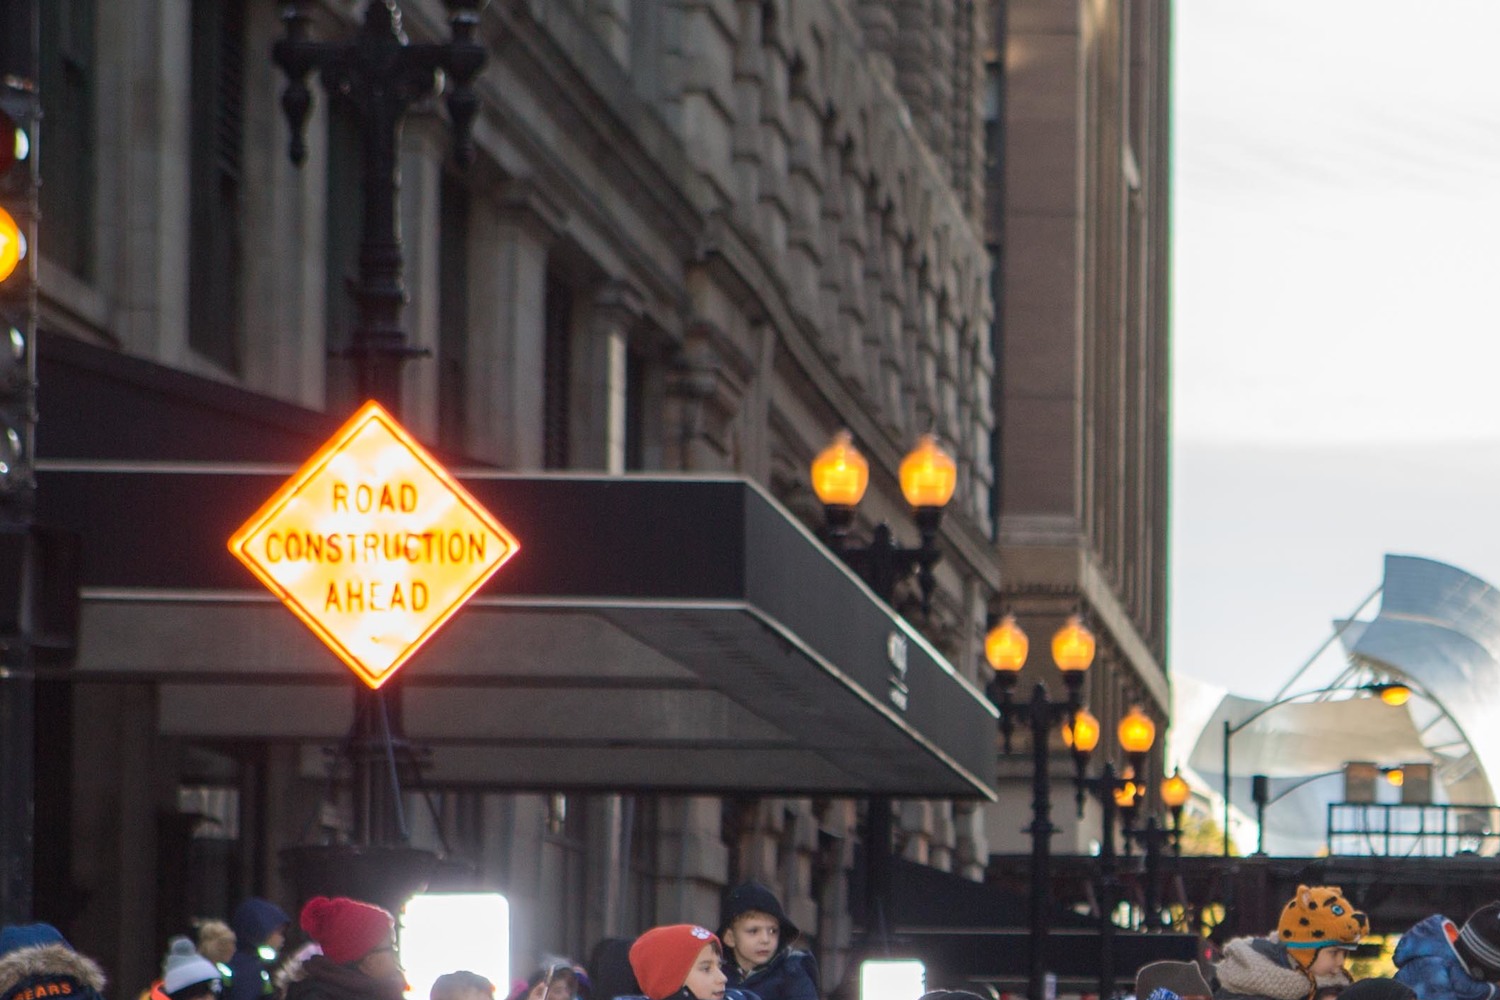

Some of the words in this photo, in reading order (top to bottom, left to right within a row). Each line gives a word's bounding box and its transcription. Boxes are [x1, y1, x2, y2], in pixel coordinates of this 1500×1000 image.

[333, 484, 417, 513] ROAD
[265, 533, 486, 563] CONSTRUCTION
[325, 583, 428, 612] AHEAD
